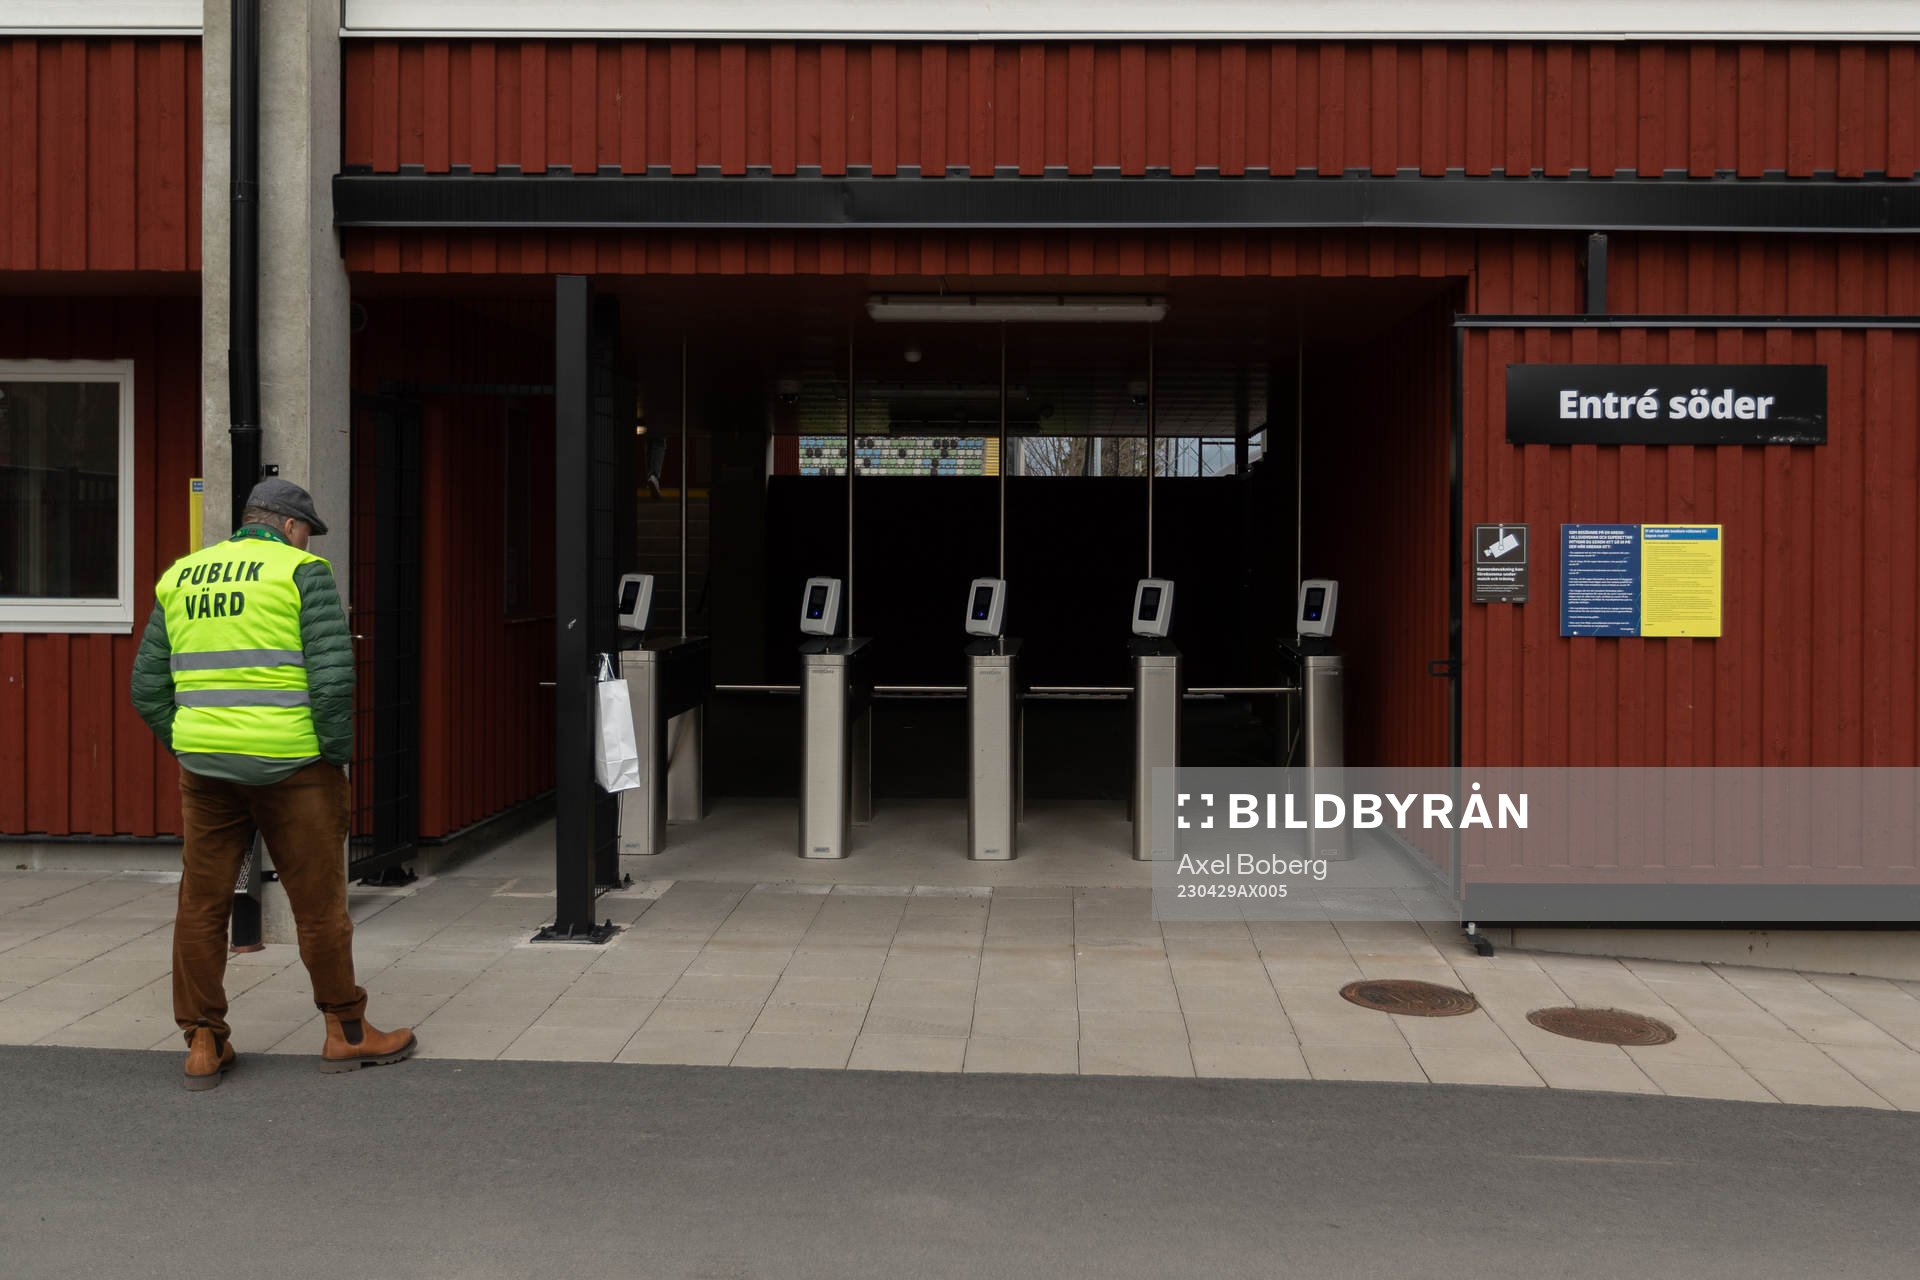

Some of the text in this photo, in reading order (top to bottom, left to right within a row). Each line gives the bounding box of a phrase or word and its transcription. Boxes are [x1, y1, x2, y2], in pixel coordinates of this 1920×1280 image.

[1559, 388, 1774, 419] Entré söder
[176, 561, 264, 588] PUBLIK
[185, 587, 245, 620] VÄRD
